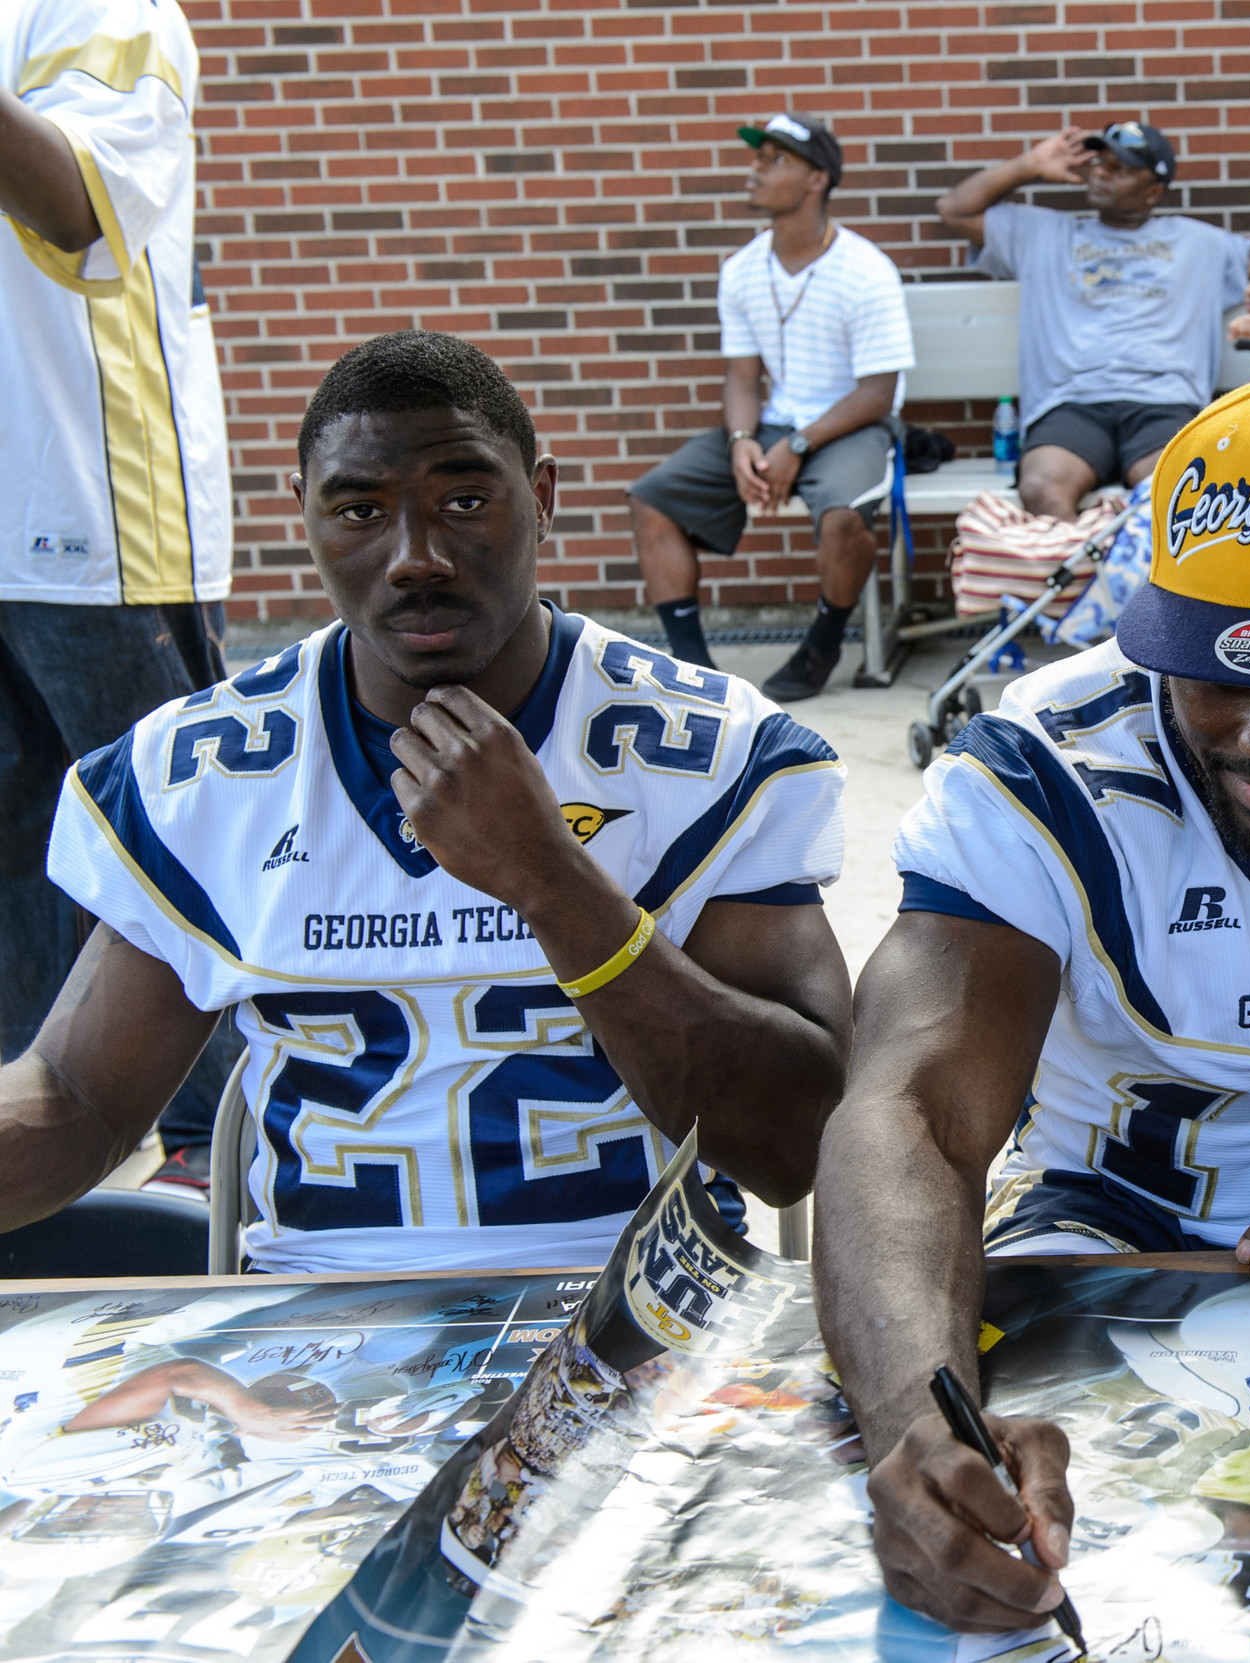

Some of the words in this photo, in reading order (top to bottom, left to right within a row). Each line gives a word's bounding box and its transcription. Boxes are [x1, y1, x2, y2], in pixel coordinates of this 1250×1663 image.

[580, 637, 735, 782] 22
[262, 851, 310, 872] RUSSELL
[303, 911, 443, 951] GEORGIA
[1168, 917, 1242, 935] RUSSELL
[627, 932, 647, 956] God
[250, 984, 667, 1240] 22
[647, 1302, 692, 1341] GT
[320, 1469, 357, 1483] TECH
[361, 1464, 420, 1480] GEORGIA
